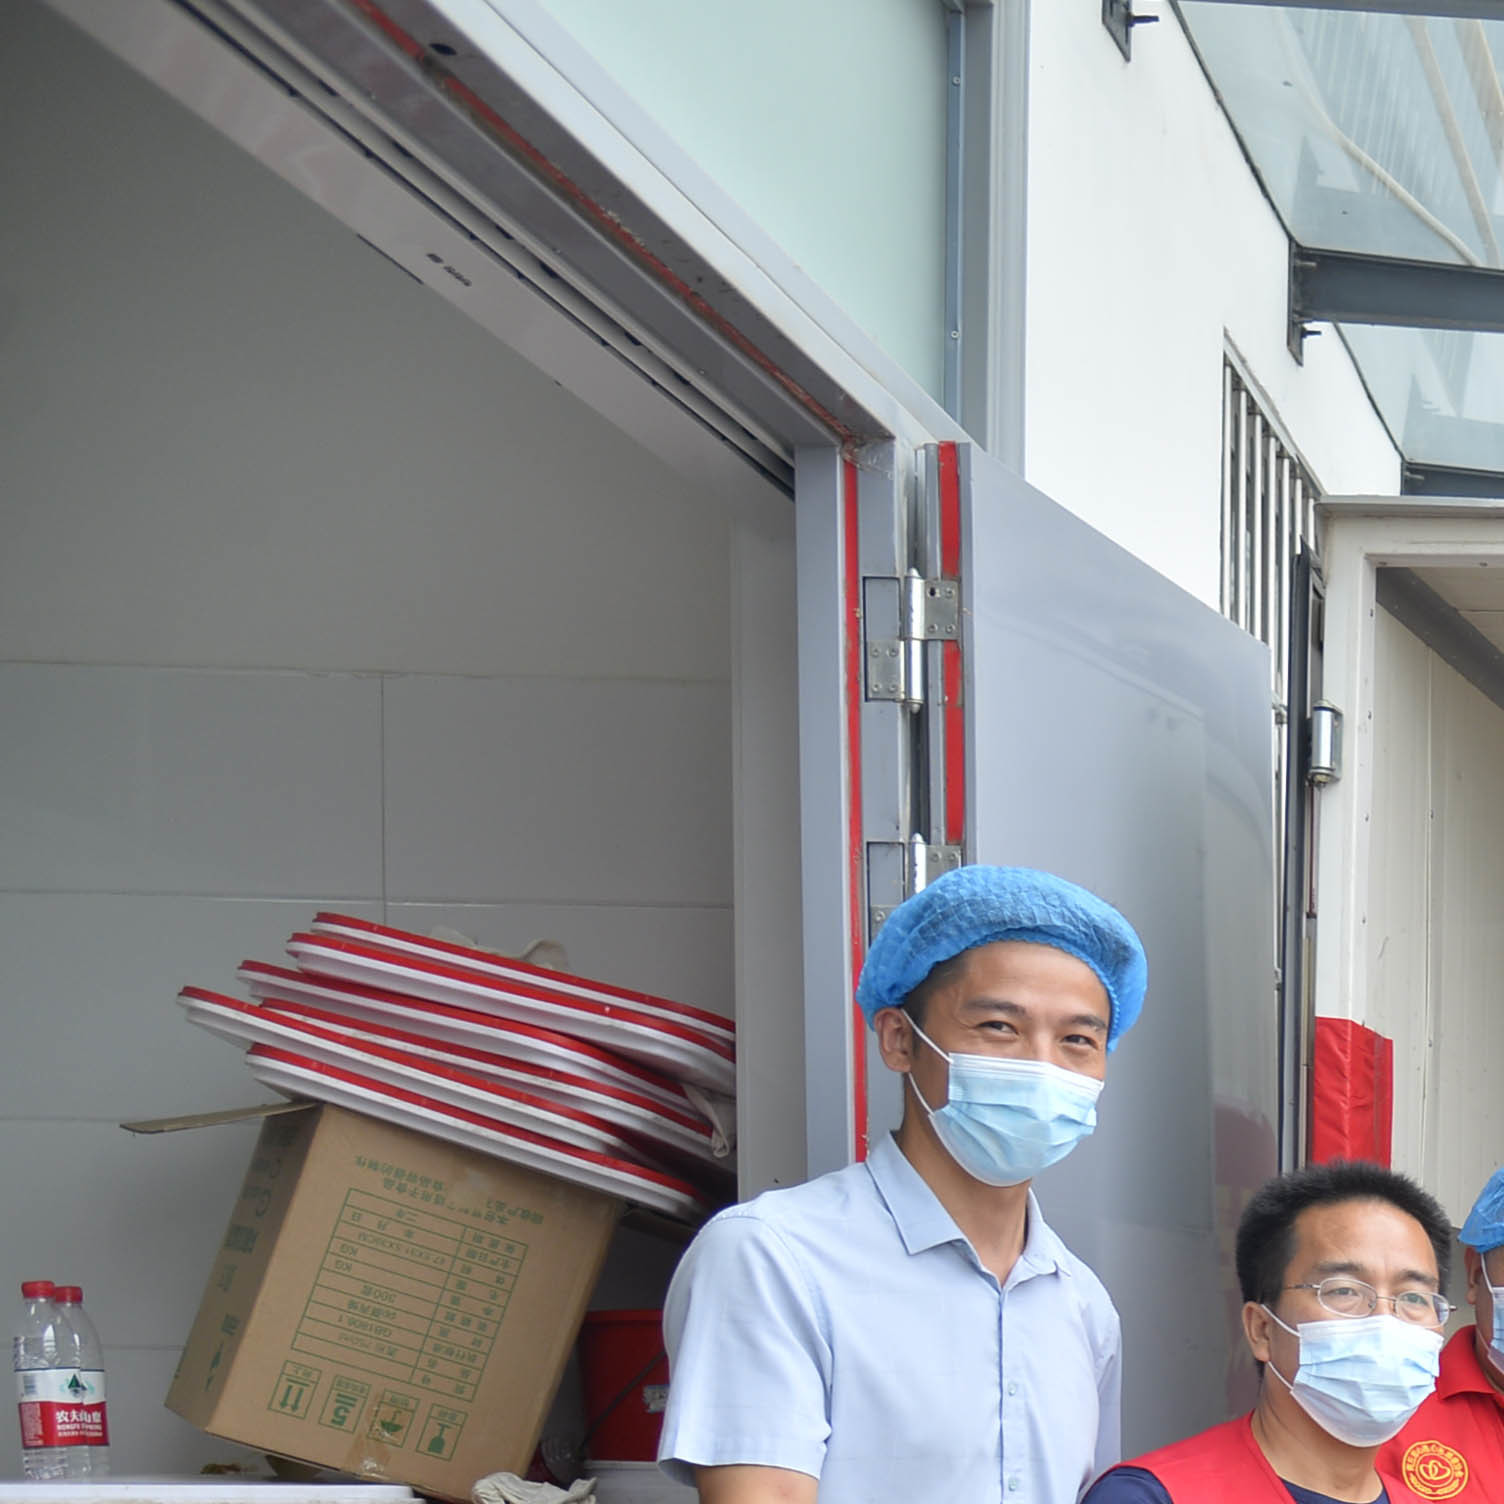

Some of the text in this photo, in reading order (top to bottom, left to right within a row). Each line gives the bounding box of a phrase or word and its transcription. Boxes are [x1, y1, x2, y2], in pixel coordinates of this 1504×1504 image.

[338, 1242, 359, 1257] KG
[332, 1258, 353, 1273] KG
[328, 1403, 351, 1427] 5
